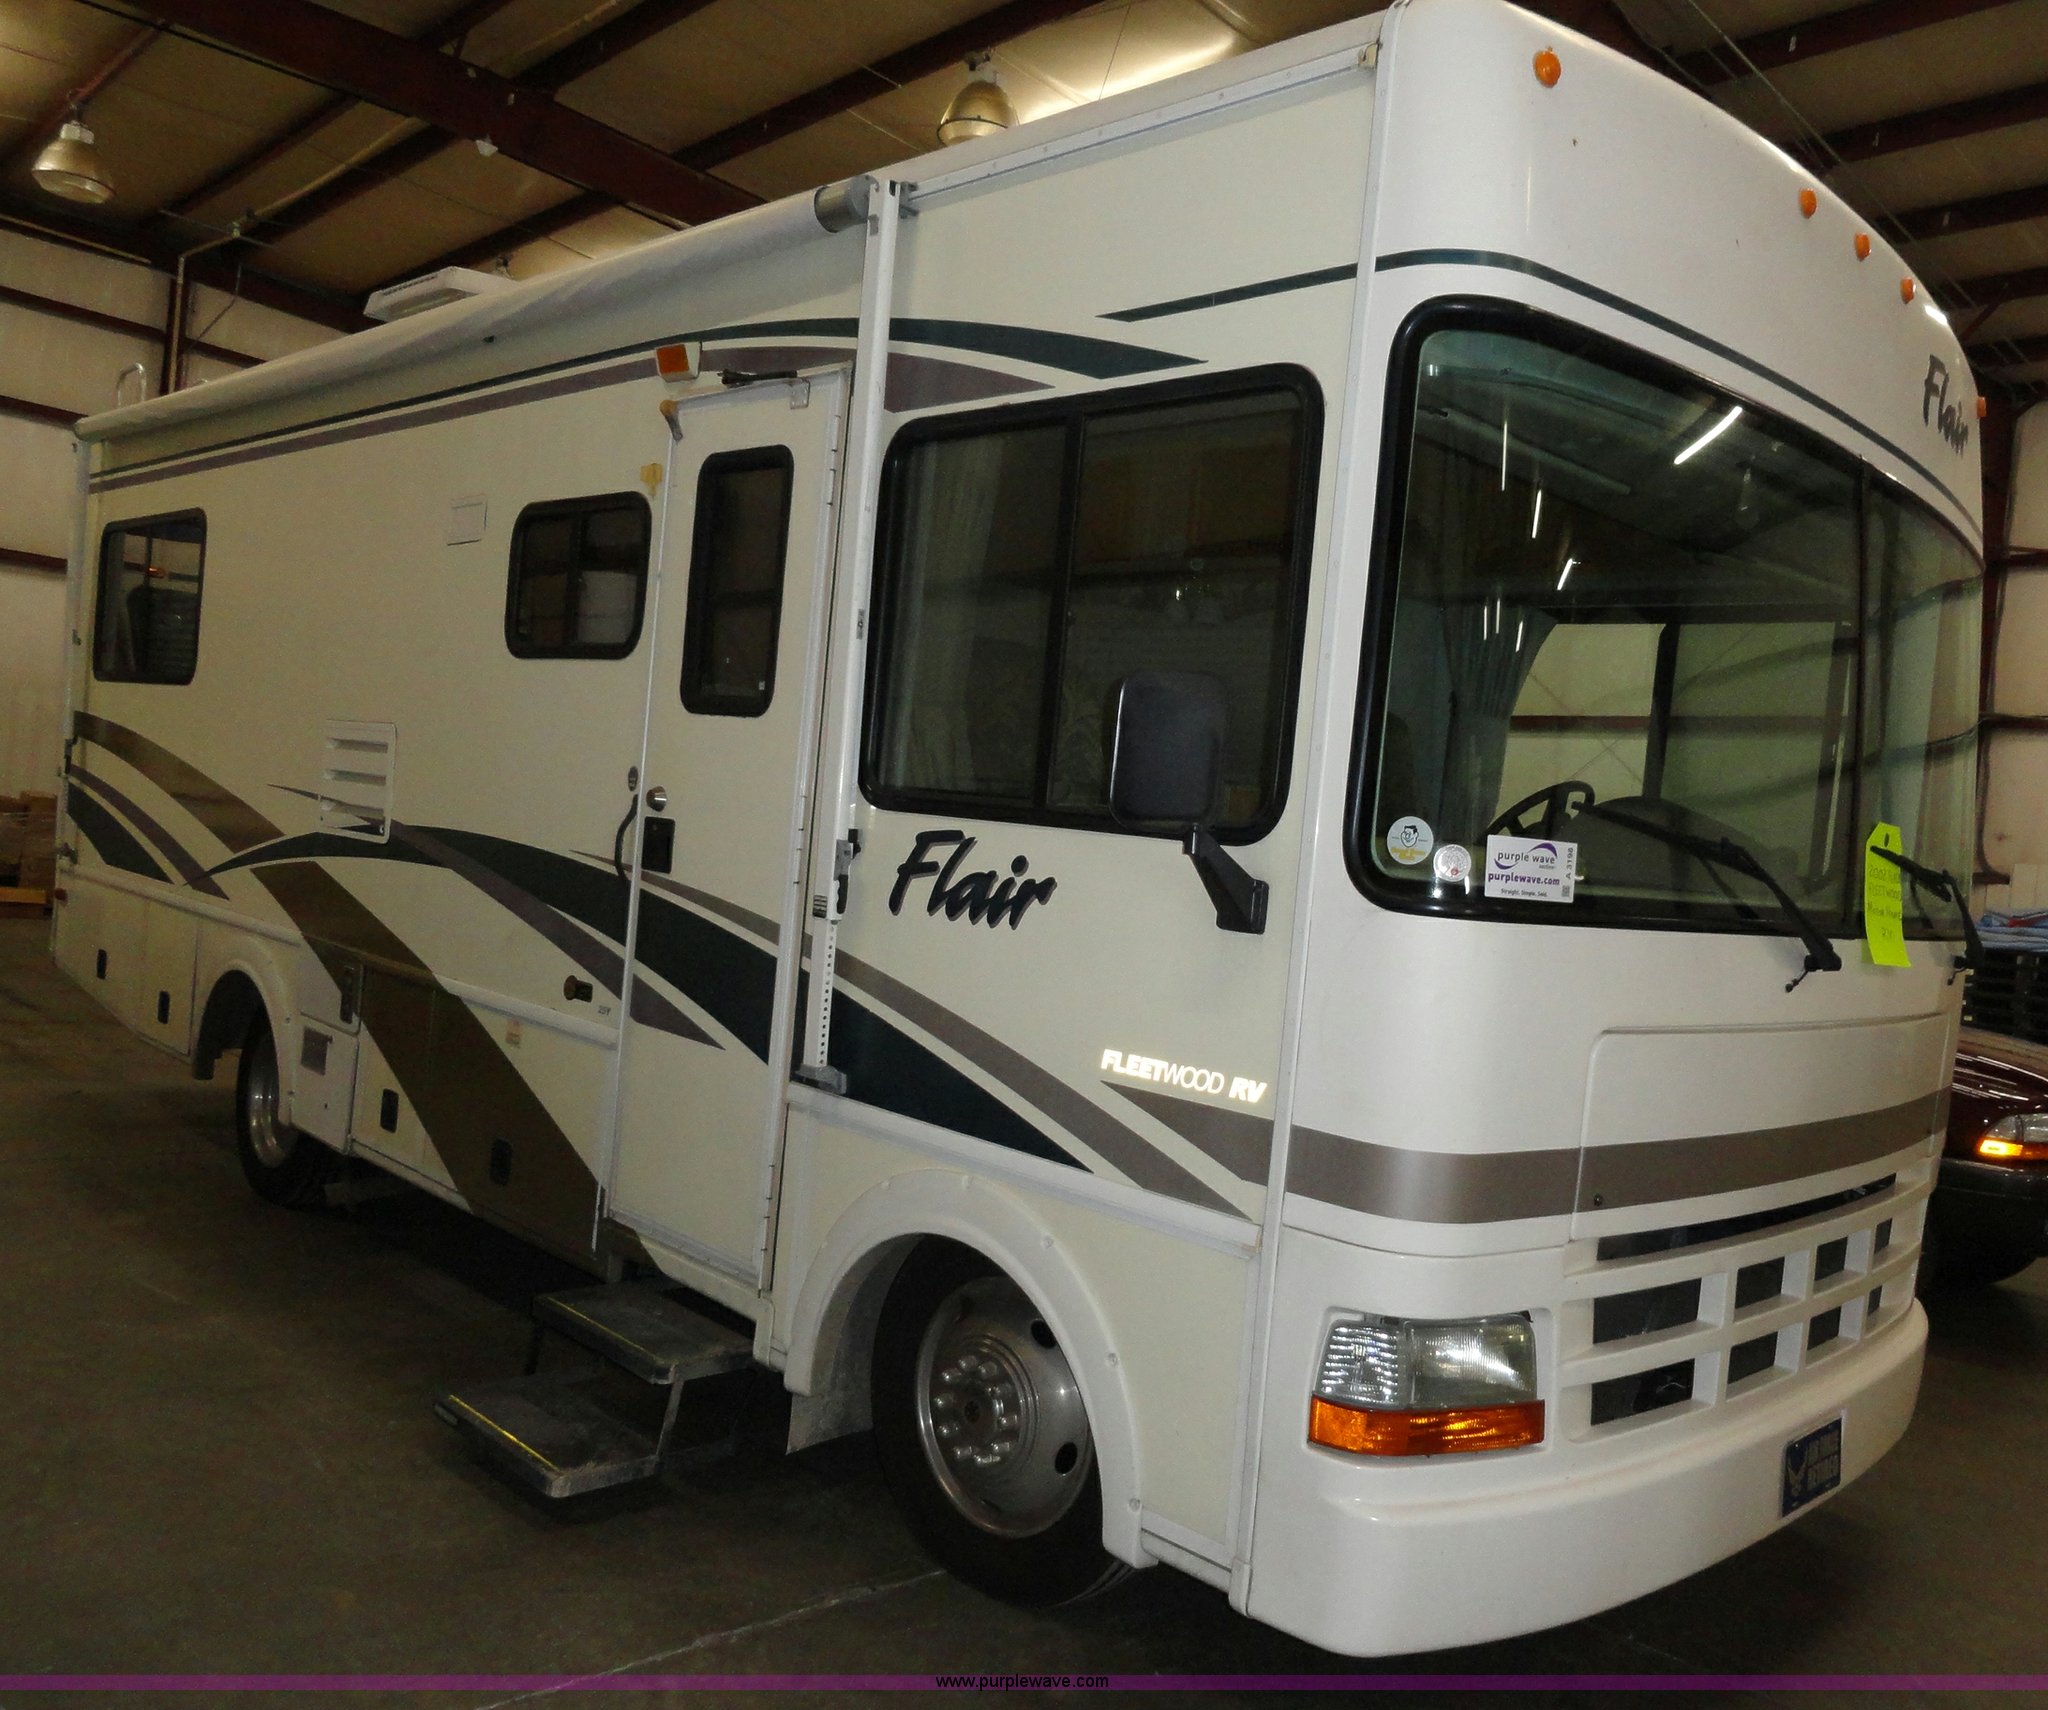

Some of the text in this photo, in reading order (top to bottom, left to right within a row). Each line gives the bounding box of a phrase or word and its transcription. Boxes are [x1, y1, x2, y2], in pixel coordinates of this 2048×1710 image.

[1923, 354, 1968, 458] Flair
[889, 830, 1057, 930] Flair
[1488, 872, 1560, 885] purplewave.com
[1498, 852, 1555, 864] purple wave
[1101, 1048, 1268, 1103] FLEETWOOD RV
